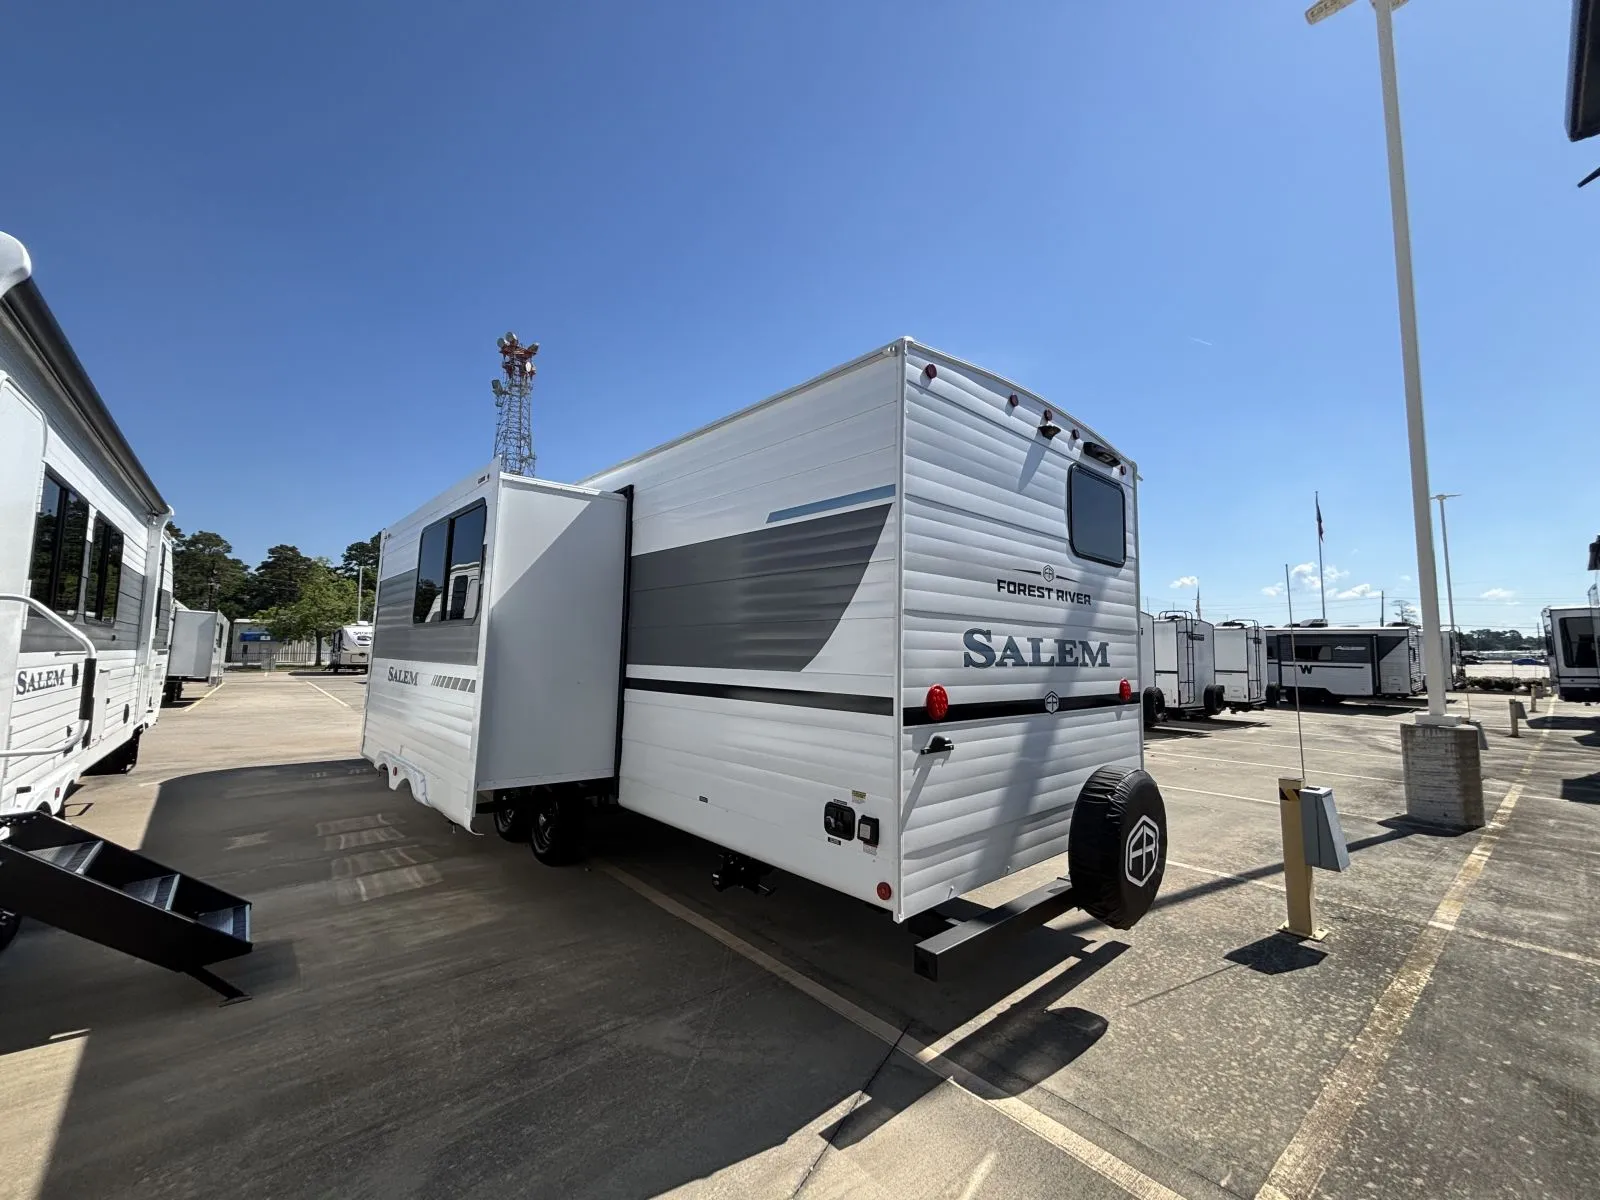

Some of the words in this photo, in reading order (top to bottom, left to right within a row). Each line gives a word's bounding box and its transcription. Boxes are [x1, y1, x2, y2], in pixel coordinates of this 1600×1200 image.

[997, 579, 1054, 600] FOREST
[1056, 589, 1092, 606] RIVER
[963, 628, 1110, 669] SALEM
[16, 669, 66, 696] SALEM
[388, 666, 420, 687] SALEM
[1300, 664, 1313, 675] W
